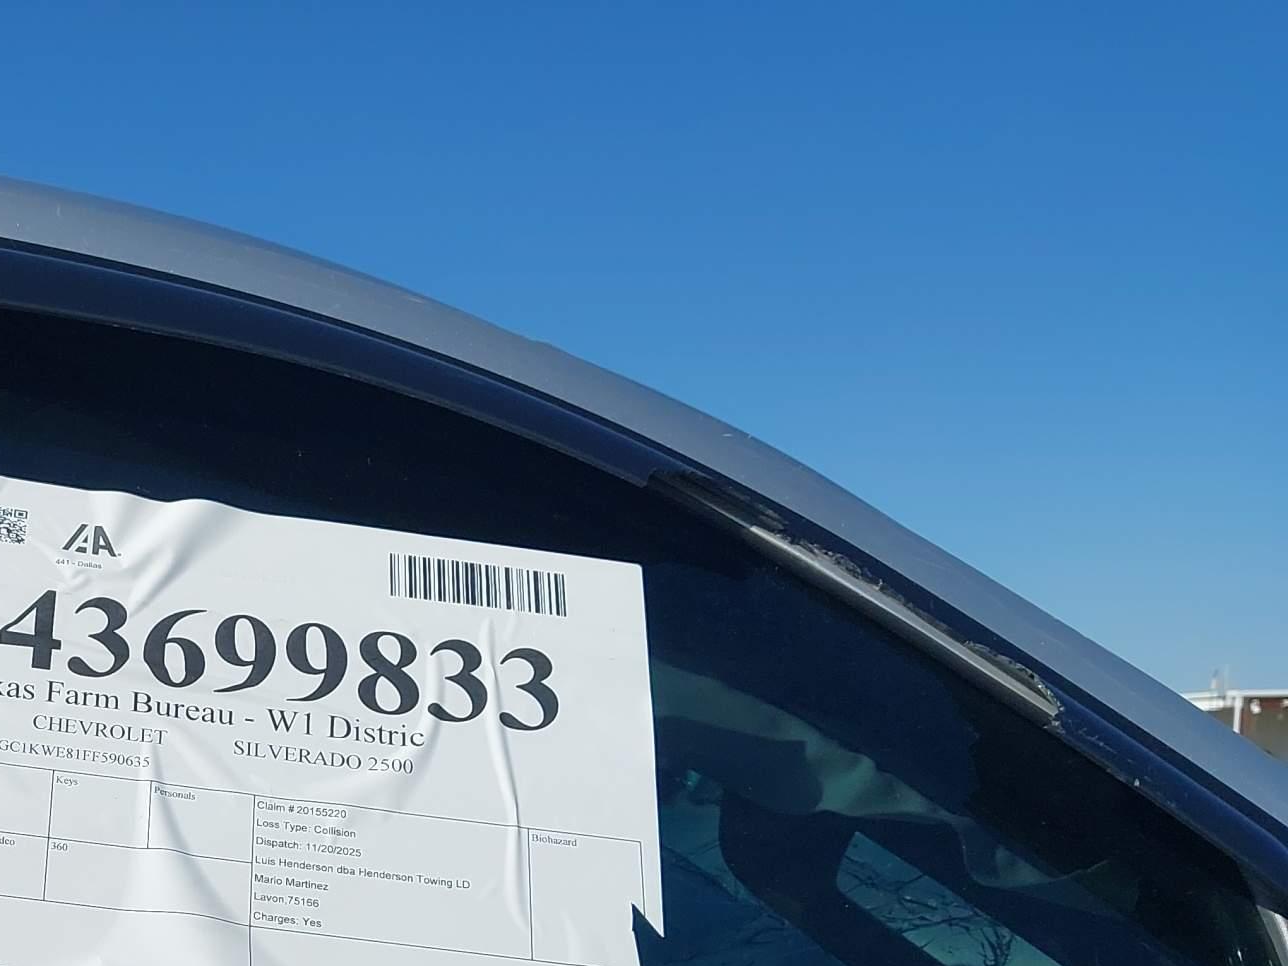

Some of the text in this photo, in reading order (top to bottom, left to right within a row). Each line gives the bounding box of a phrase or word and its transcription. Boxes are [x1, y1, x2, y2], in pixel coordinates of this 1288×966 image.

[77, 561, 102, 569] Dallas
[0, 589, 559, 731] 43699833
[46, 680, 120, 710] Farm
[131, 691, 234, 725] Bureau
[267, 708, 313, 736] W1
[327, 715, 425, 747] Distric
[32, 714, 168, 745] CHEVROLET
[233, 740, 362, 770] SILVERADO
[367, 757, 414, 775] 2500
[56, 776, 78, 786] Keys
[154, 786, 196, 801] Personals
[257, 801, 286, 812] Claim
[296, 806, 347, 819] 20155220
[256, 818, 356, 838] Loss Type: Collision
[51, 842, 68, 851] 360
[256, 836, 362, 857] Dispatch: 11/20/2025
[531, 833, 577, 848] Biohazard
[255, 856, 471, 889] Luis Henderson dba Henderson Towing LD
[254, 873, 329, 891] Mario Martinez
[253, 911, 322, 928] Charges: Yes
